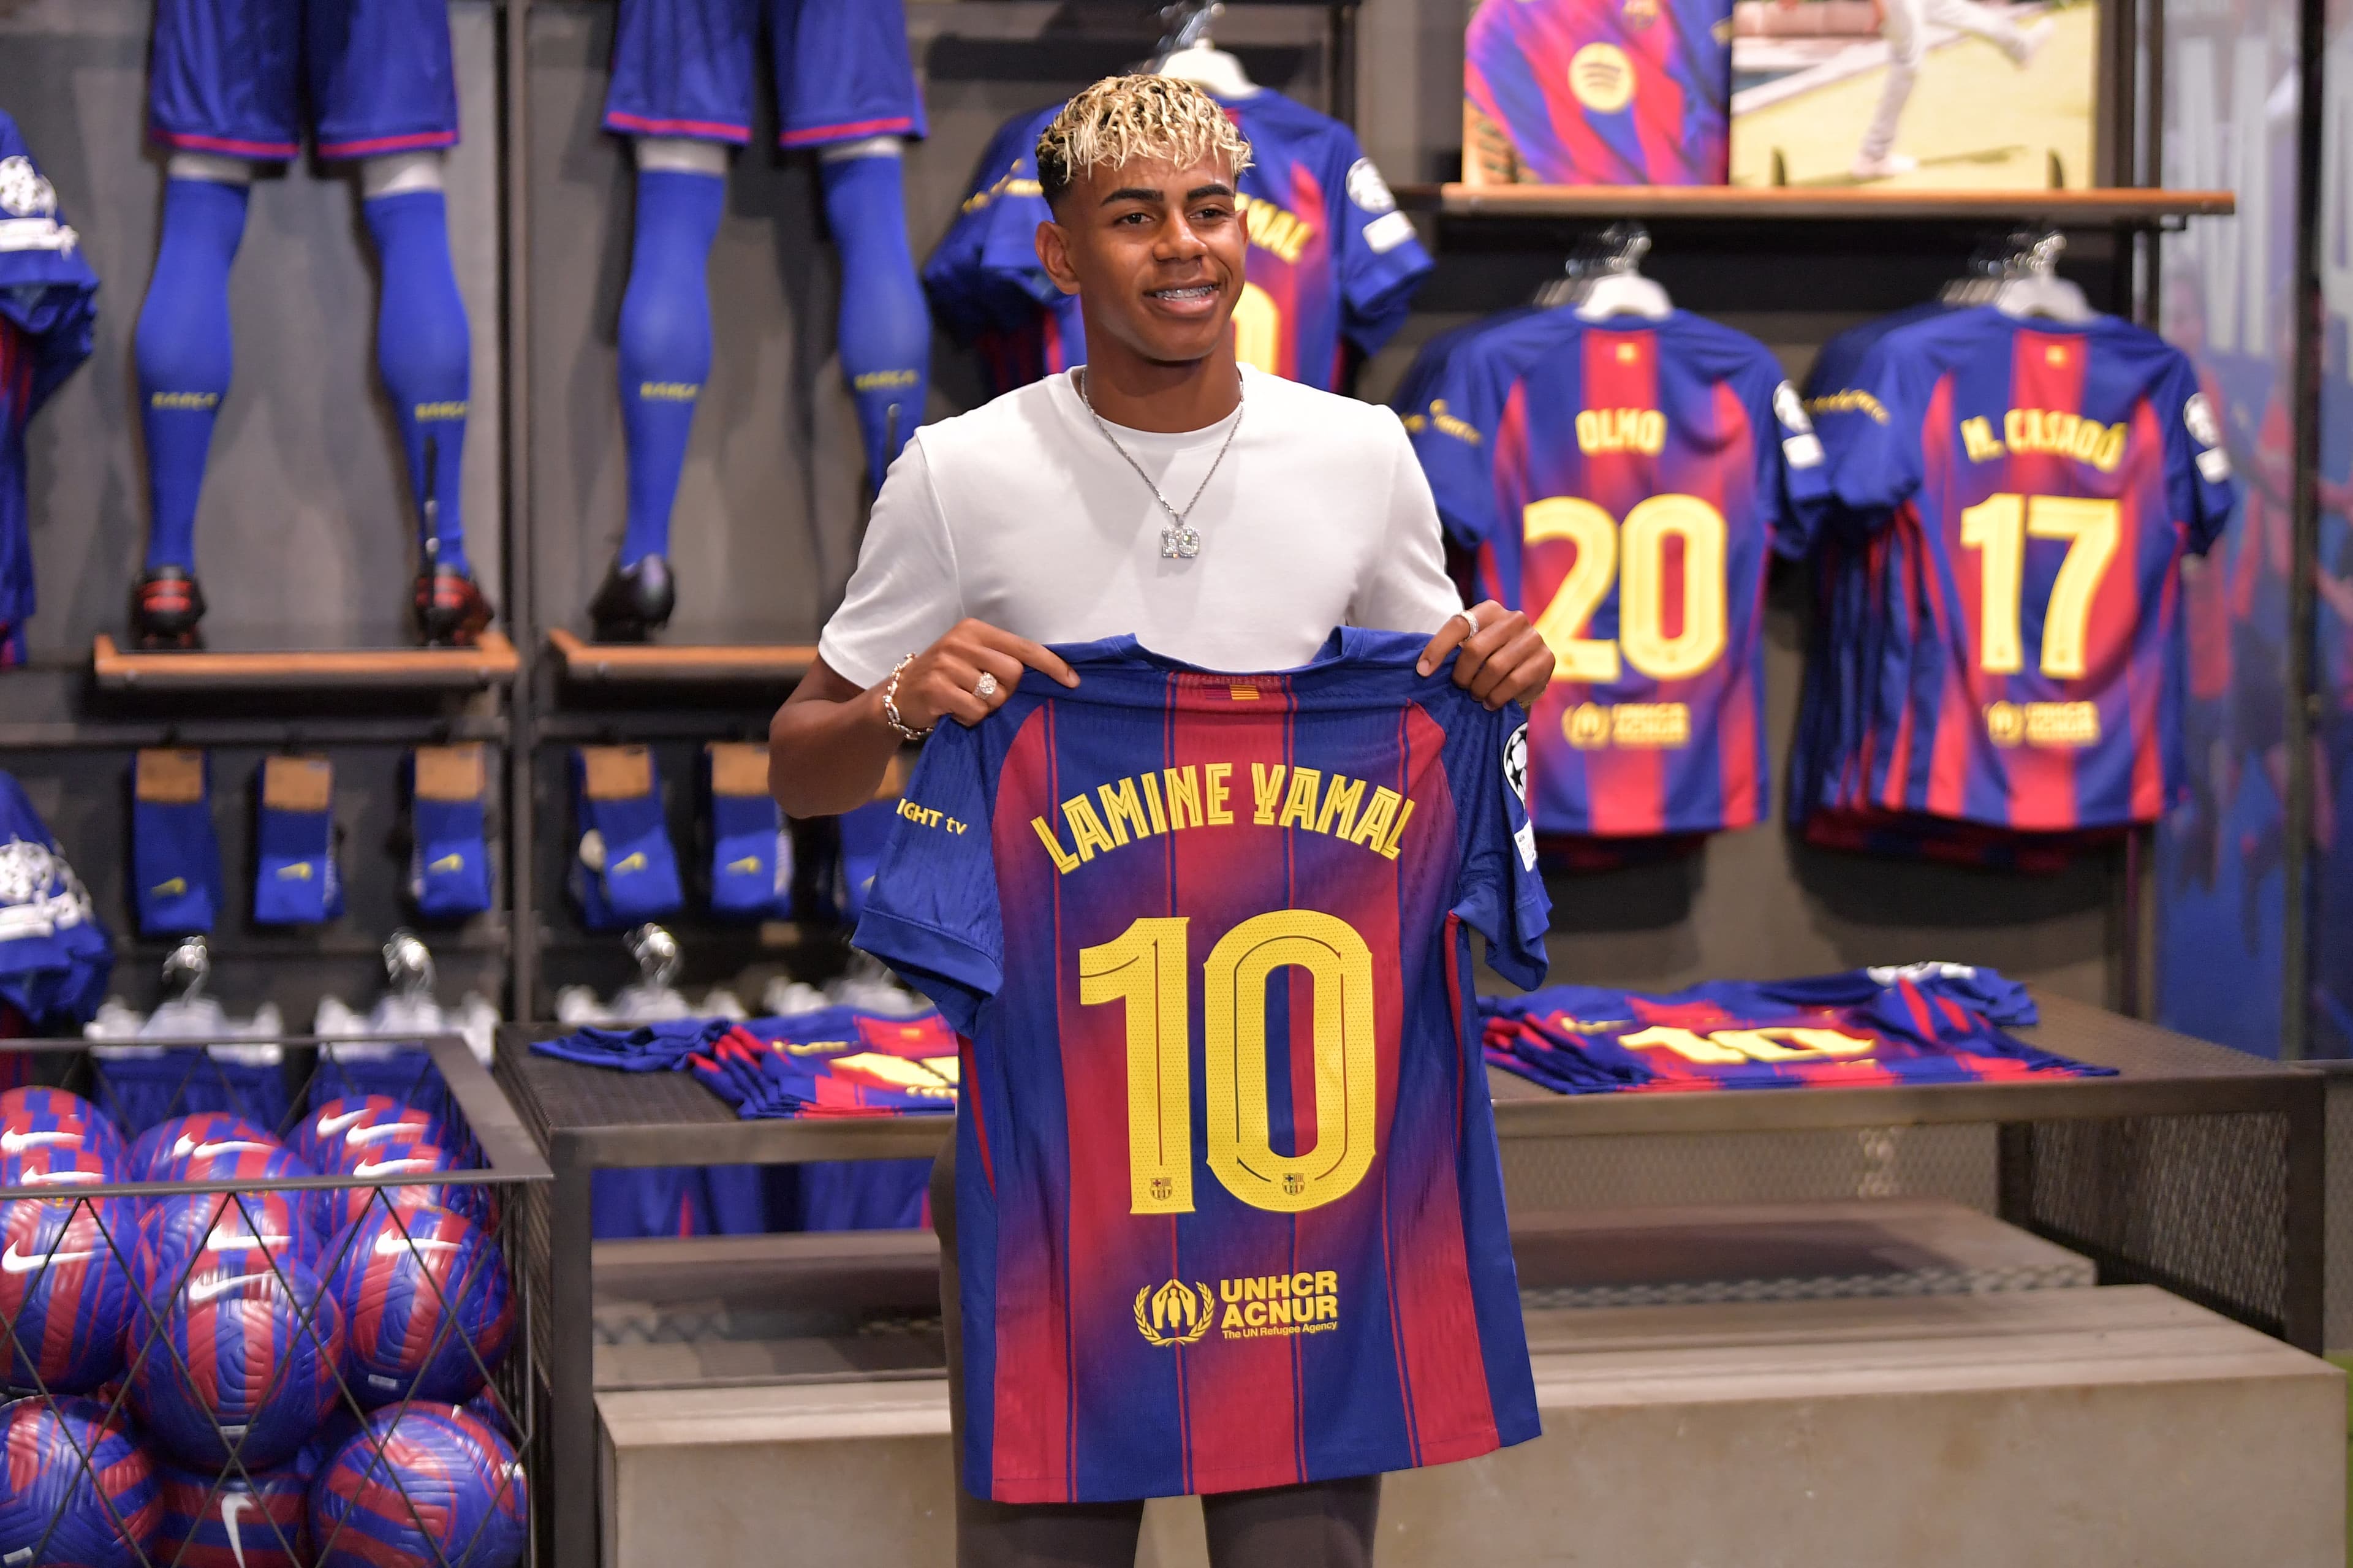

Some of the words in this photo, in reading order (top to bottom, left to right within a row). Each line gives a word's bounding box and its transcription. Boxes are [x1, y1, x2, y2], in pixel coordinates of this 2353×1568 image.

[1575, 407, 1668, 455] OLMO
[1523, 493, 1728, 681] 20
[1960, 492, 2121, 680] 17
[896, 798, 944, 828] IGHT
[946, 817, 968, 835] tv
[1030, 762, 1233, 874] LAMINE
[1251, 762, 1415, 860] YAMAL
[1079, 909, 1376, 1214] 10
[1618, 1025, 1876, 1064] 10
[1220, 1270, 1338, 1302] UNHCR
[1220, 1295, 1338, 1328] ACNUR
[1222, 1330, 1241, 1339] The
[1243, 1328, 1258, 1337] UN
[1260, 1325, 1300, 1336] Refugee
[1302, 1321, 1338, 1333] Agency
